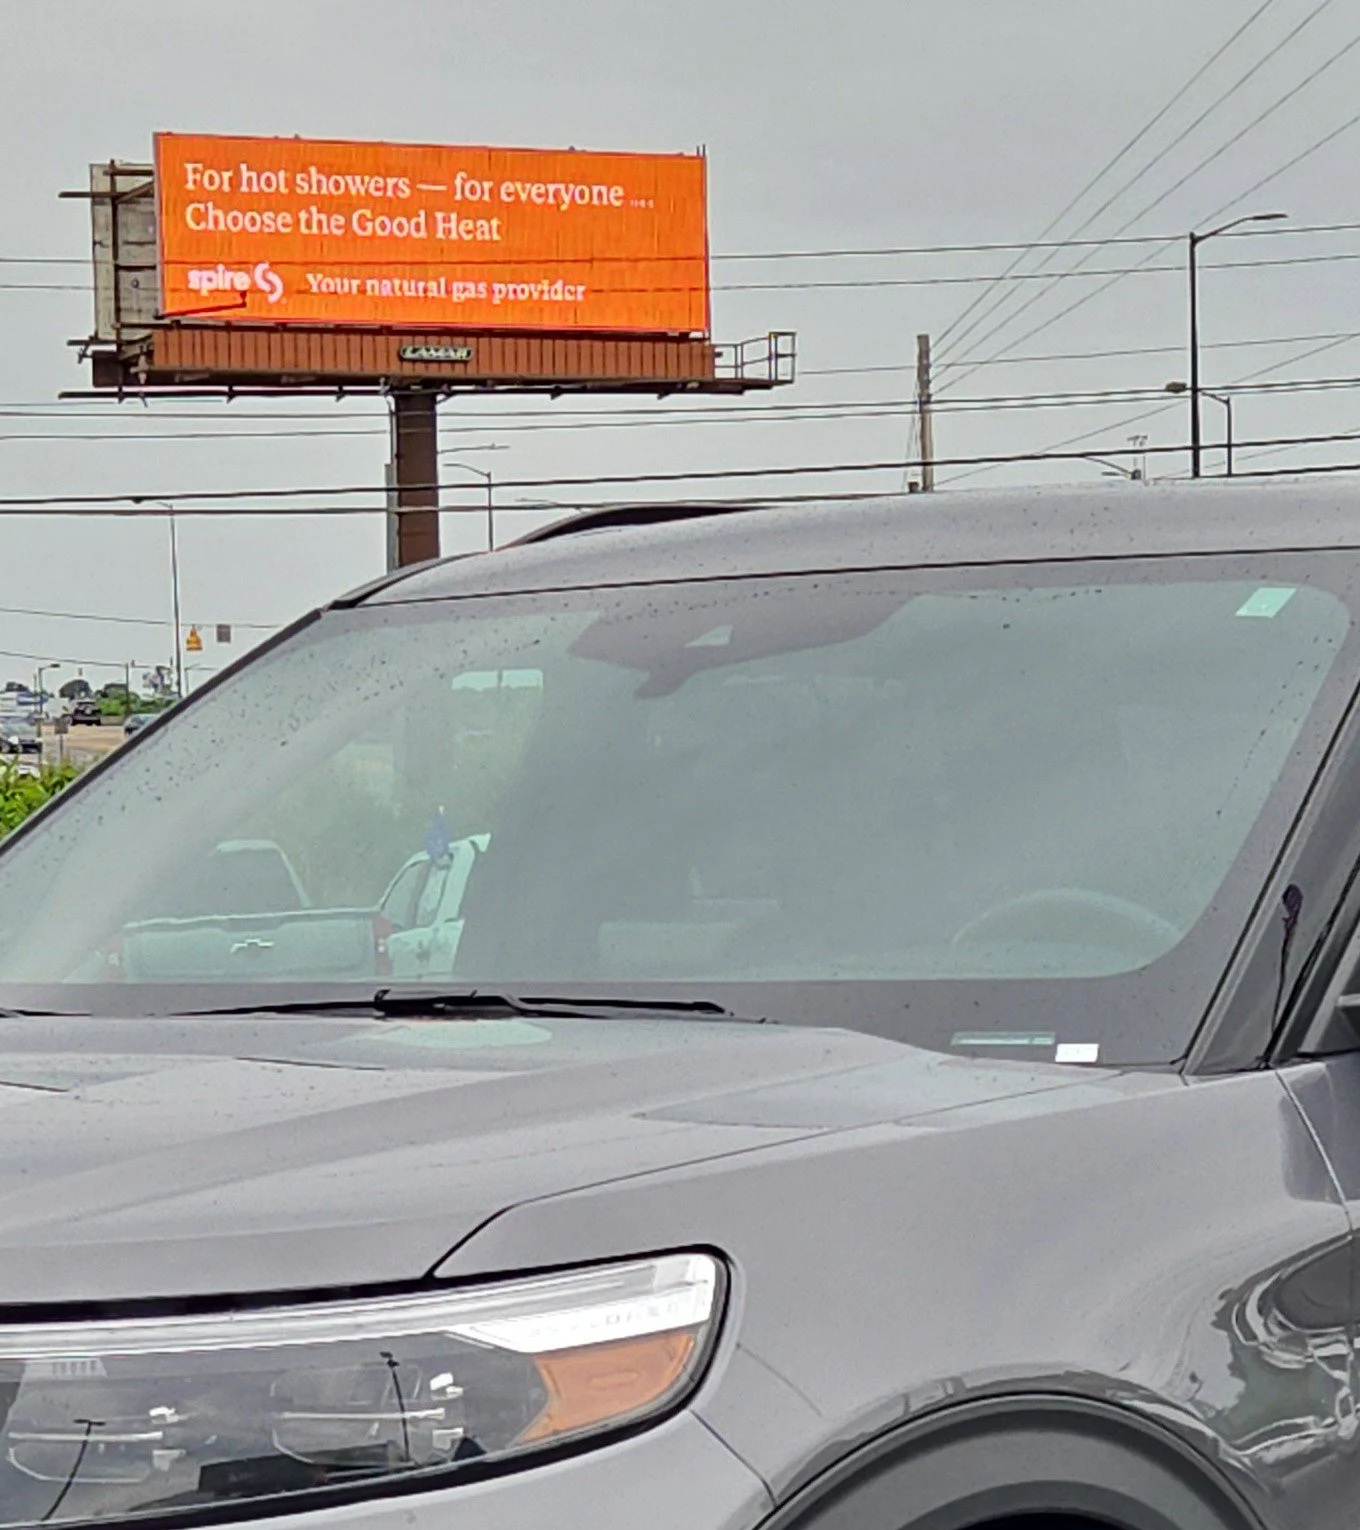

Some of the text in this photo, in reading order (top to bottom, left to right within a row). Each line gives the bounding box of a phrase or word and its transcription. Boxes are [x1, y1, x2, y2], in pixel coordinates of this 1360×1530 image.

[184, 162, 234, 193] For
[240, 163, 290, 194] hot
[295, 166, 411, 199] showers
[454, 171, 494, 202] for
[499, 180, 625, 211] everyone
[185, 201, 502, 242] Choose the Good Heat
[187, 264, 251, 297] spire
[305, 273, 587, 304] Your natural gas provider
